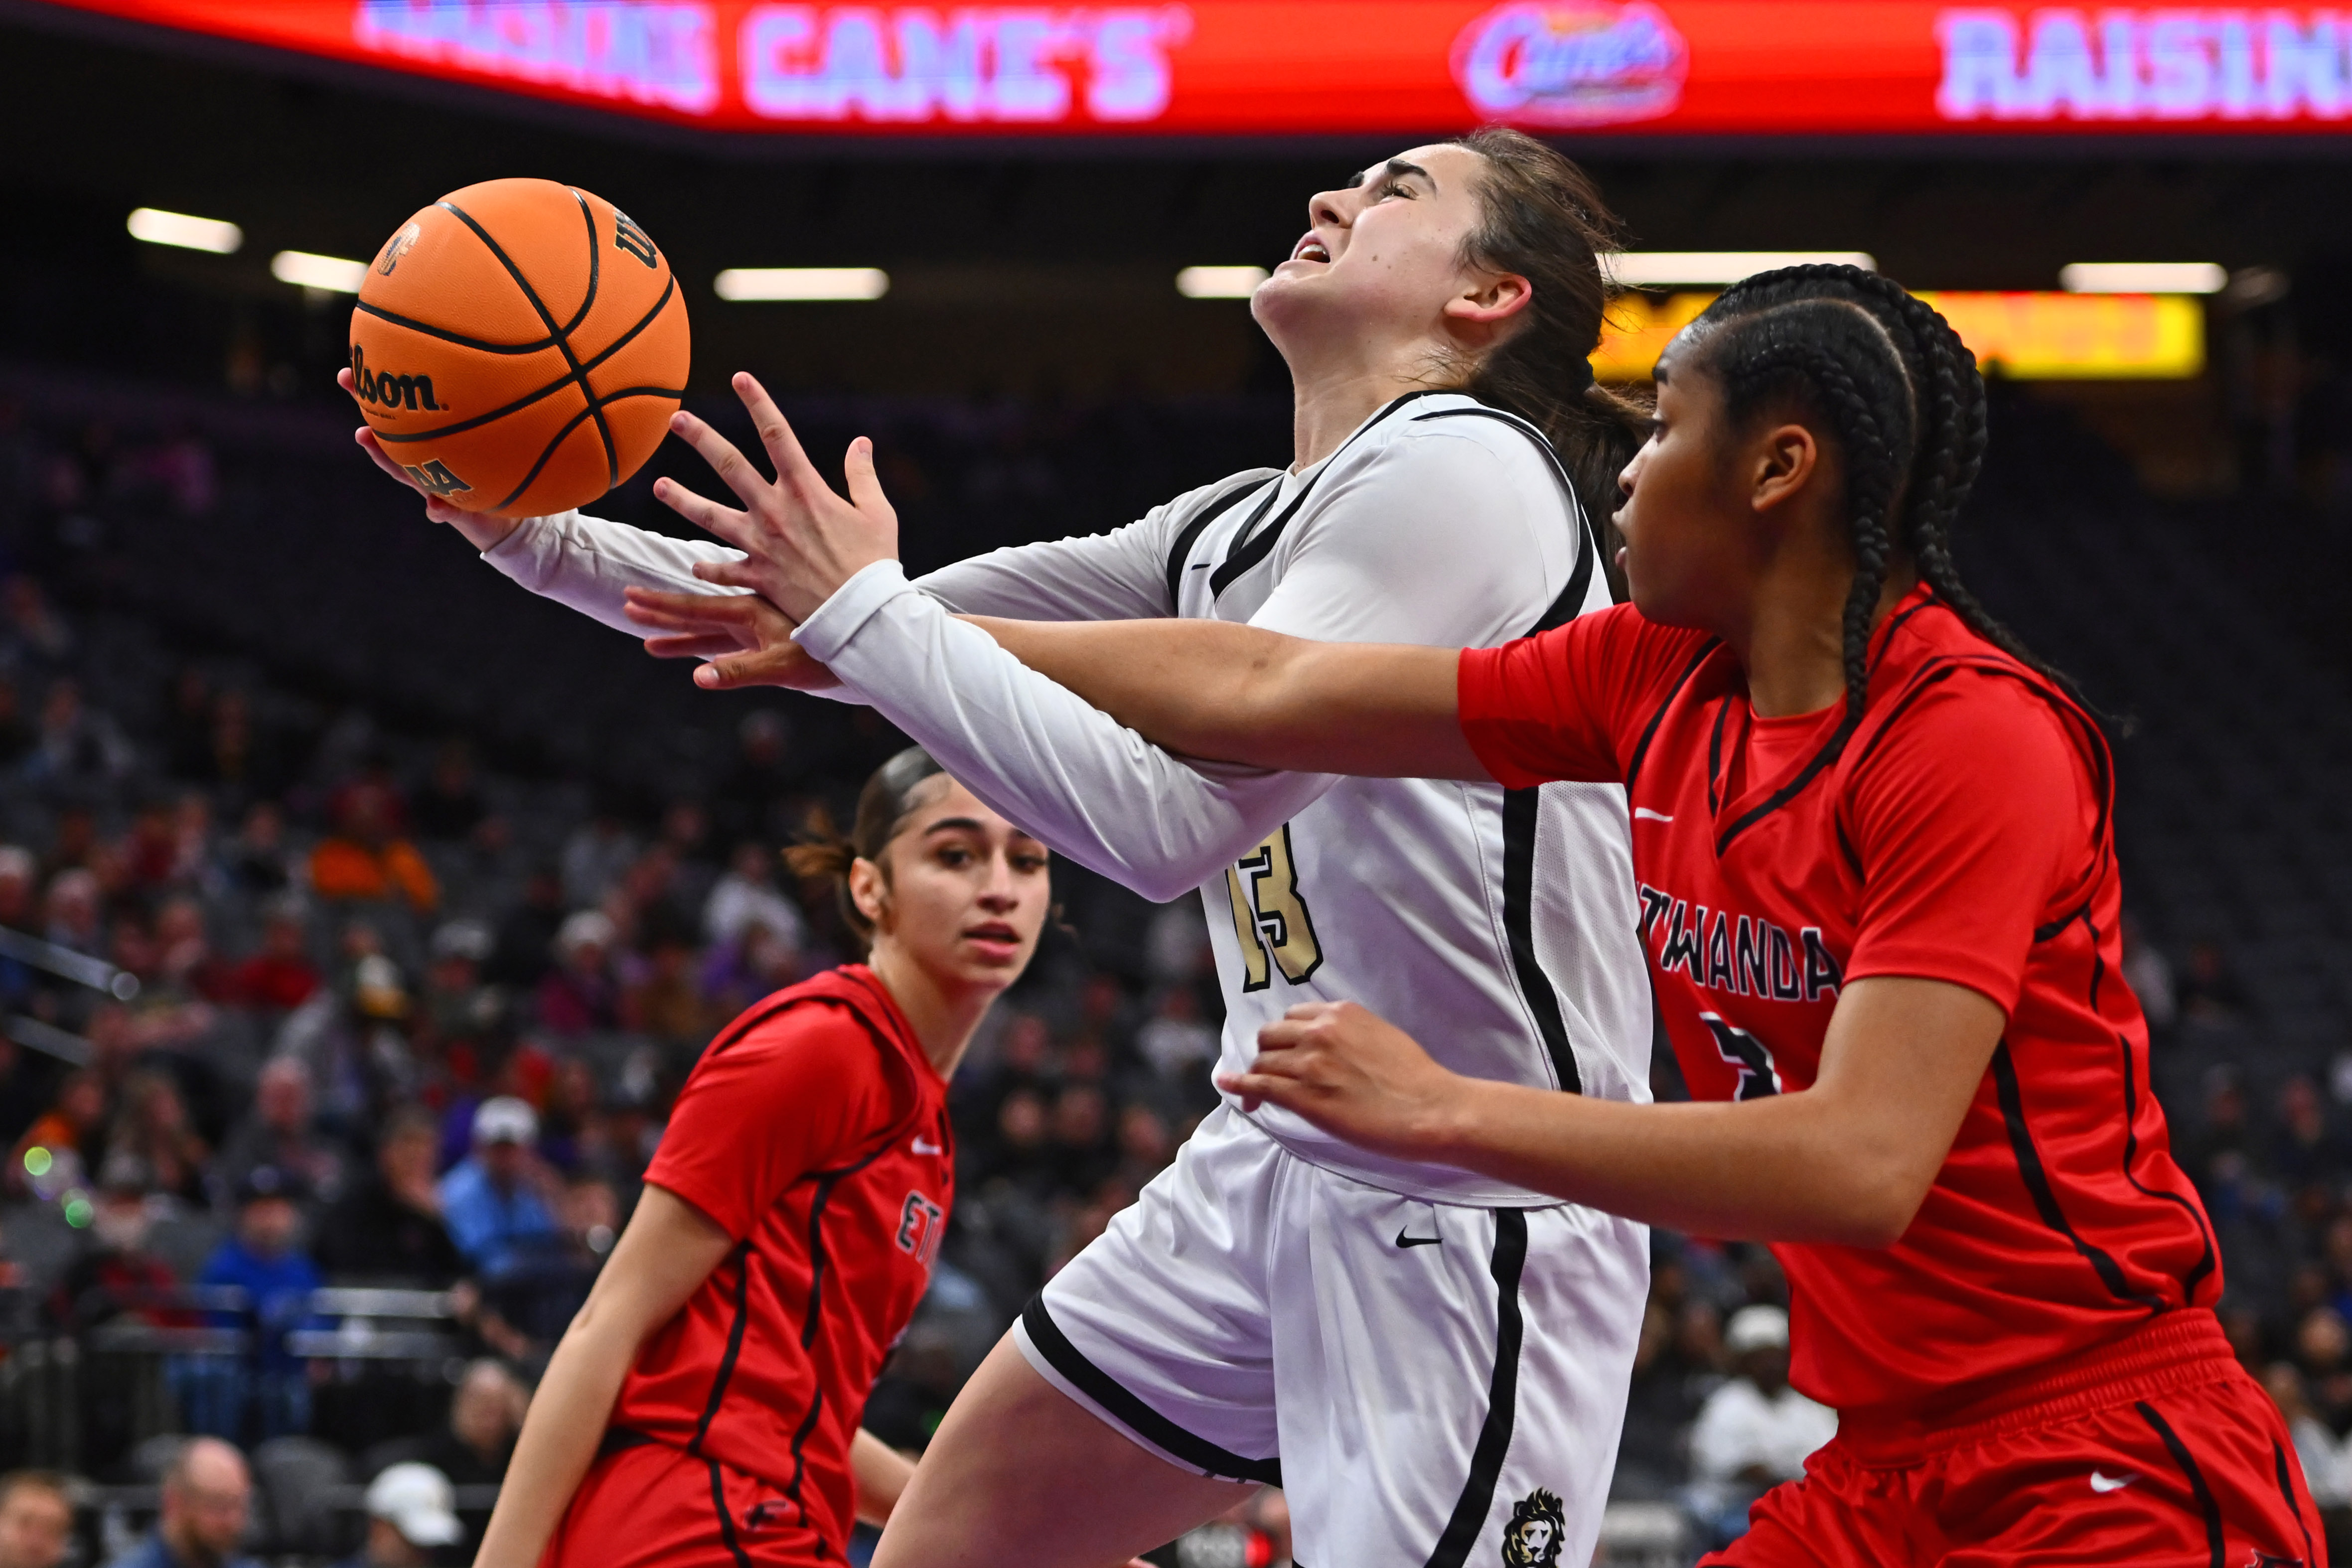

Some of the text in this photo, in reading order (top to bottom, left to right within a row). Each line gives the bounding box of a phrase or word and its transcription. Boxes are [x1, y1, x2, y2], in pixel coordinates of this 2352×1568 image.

[742, 9, 1171, 121] CANE'S
[1937, 9, 2352, 121] RAISIN
[1224, 821, 1324, 994] 13
